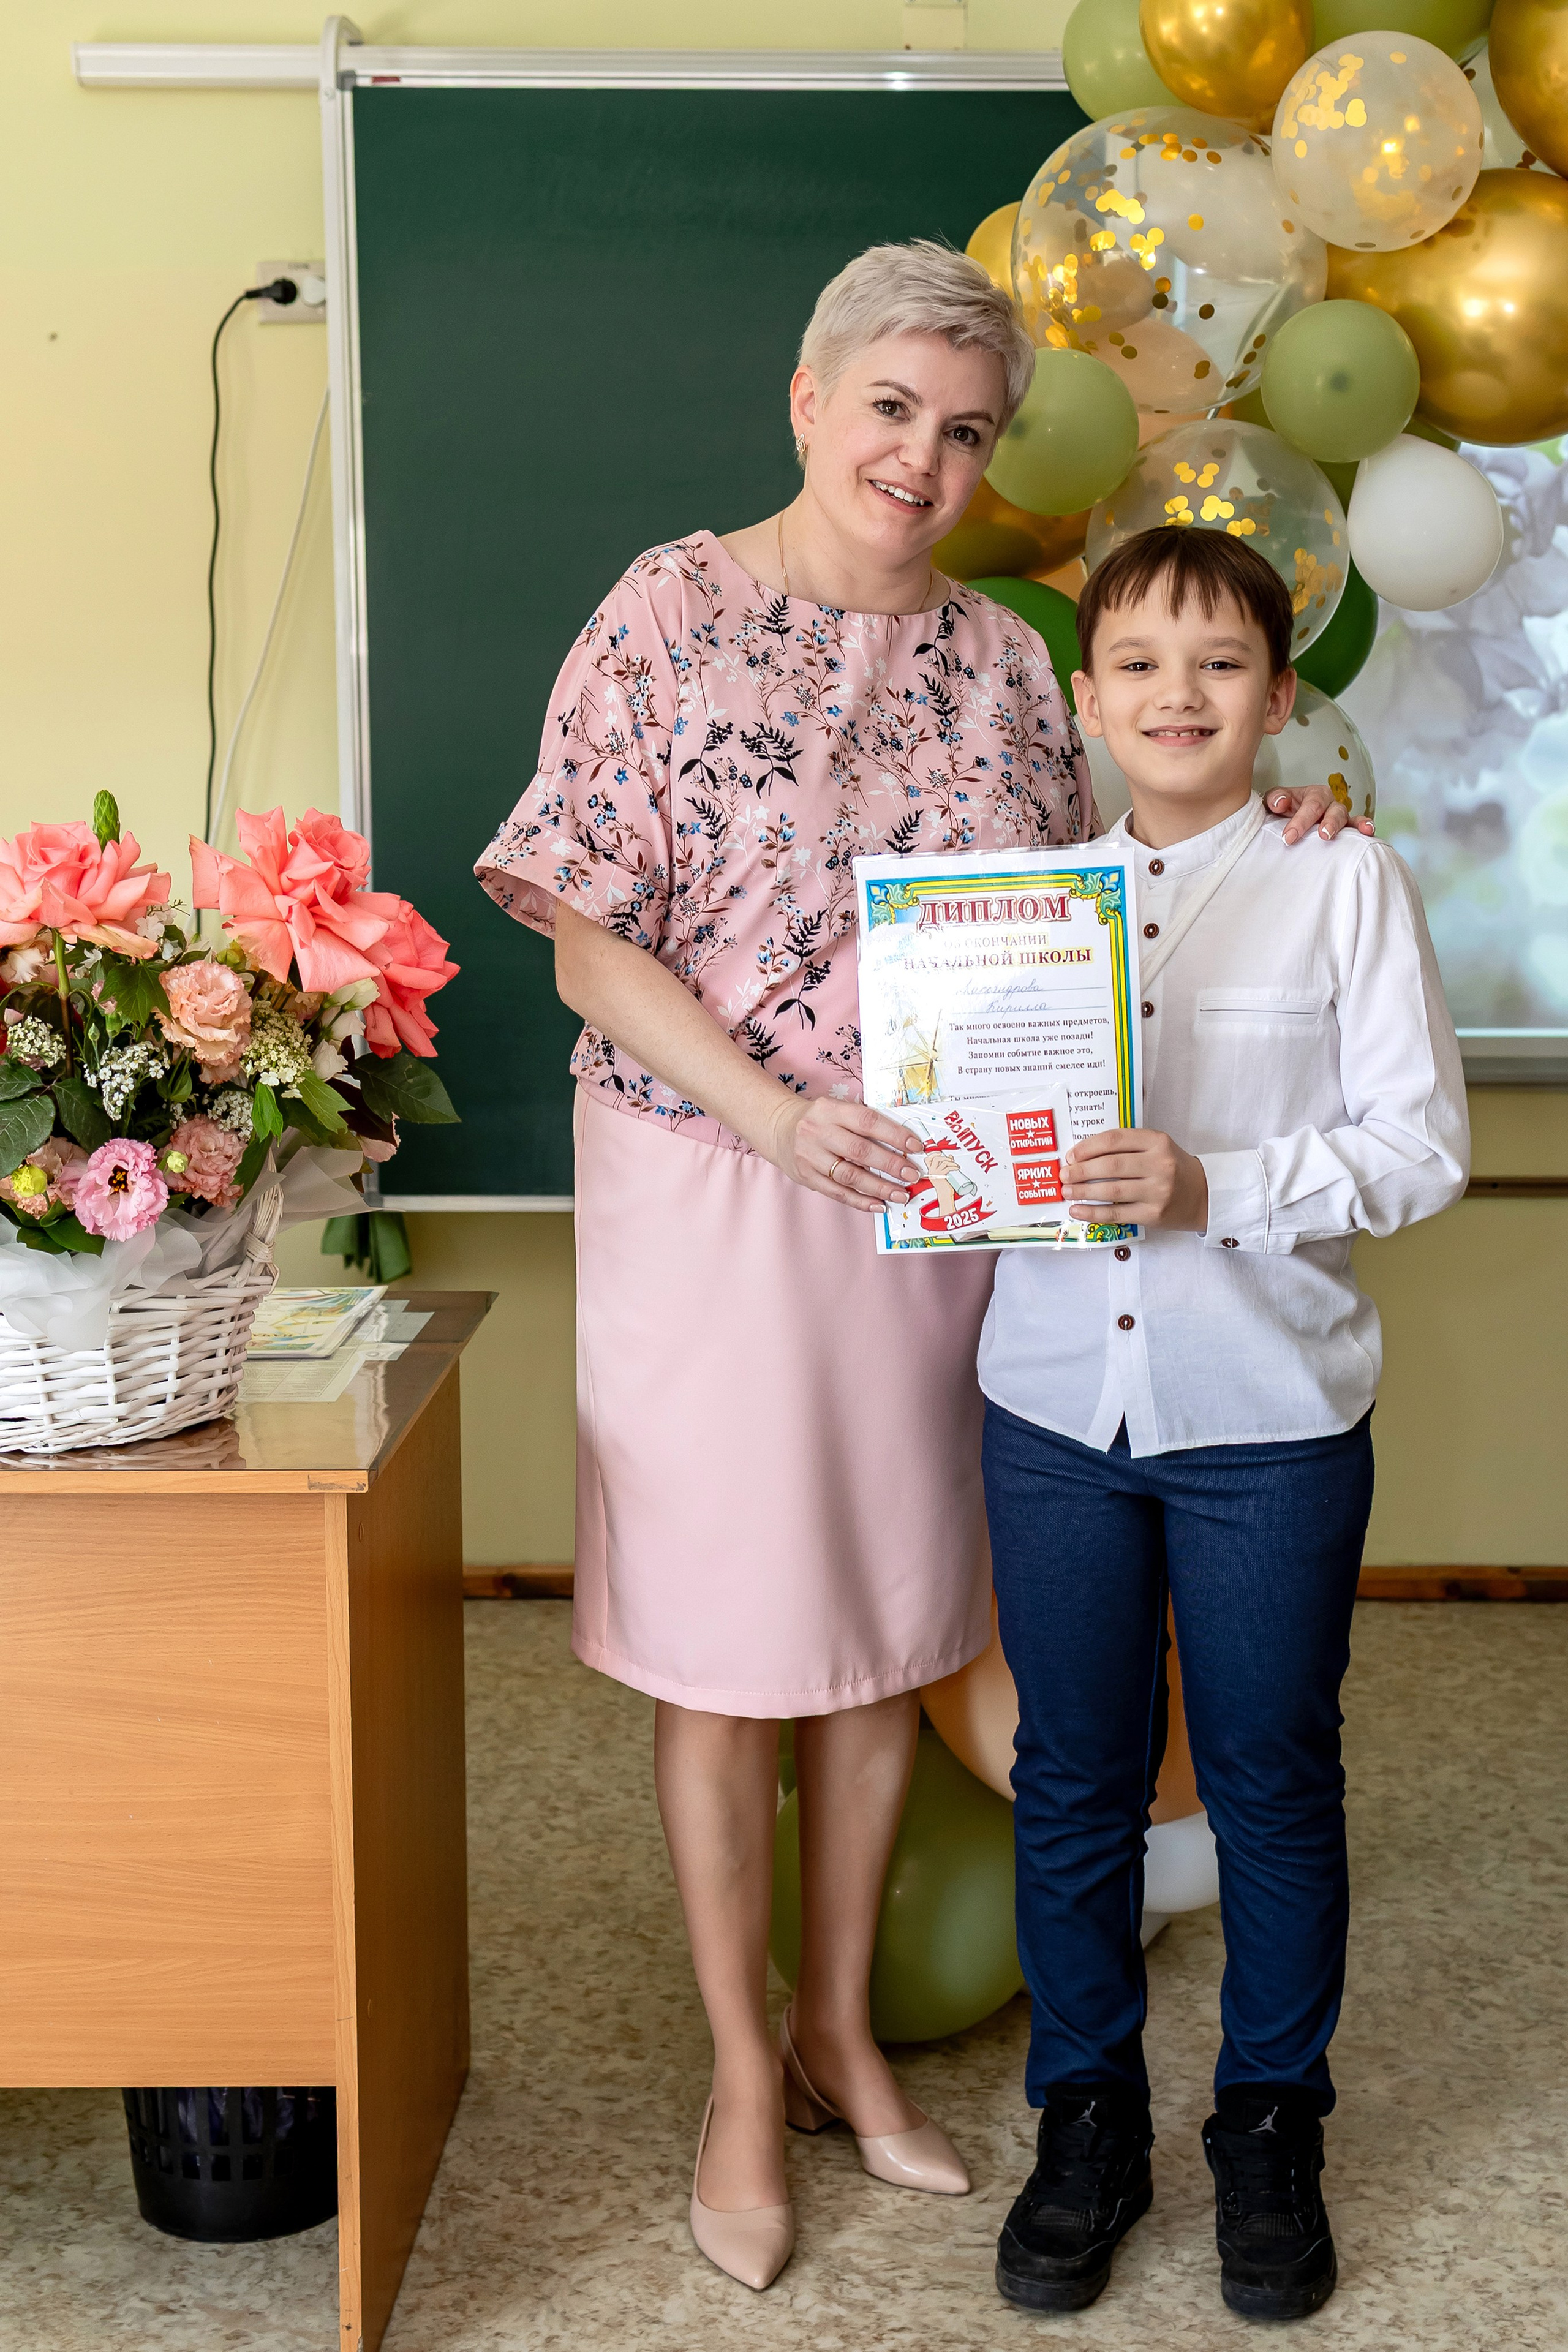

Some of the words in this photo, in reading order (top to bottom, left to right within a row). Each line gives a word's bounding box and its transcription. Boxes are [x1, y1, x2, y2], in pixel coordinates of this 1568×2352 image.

[918, 895, 1070, 930] ДИПЛОМ
[965, 934, 1047, 949] ОКОНЧАНИИ
[1019, 949, 1091, 965] ШКОЛЫ
[949, 1022, 964, 1031] Так
[1028, 1020, 1060, 1028] важных
[1063, 1018, 1110, 1028] предметов,
[967, 1036, 1011, 1045] Начальная
[1014, 1035, 1040, 1044] школа
[1042, 1035, 1058, 1045] уже
[1061, 1031, 1093, 1042] позади!
[968, 1051, 1005, 1060] Запомни
[1007, 1049, 1041, 1058] событие
[1044, 1048, 1074, 1057] важное
[1077, 1047, 1093, 1056] это,
[957, 1066, 963, 1074] В
[965, 1066, 993, 1076] страну
[995, 1065, 1021, 1074] новых
[1023, 1062, 1054, 1072] знаний
[1055, 1062, 1085, 1071] смелее
[1087, 1060, 1106, 1069] иди!
[1074, 1089, 1117, 1099] откроешь,
[1074, 1102, 1105, 1114] узнать!
[1009, 1116, 1049, 1131] НОВЫХ
[1081, 1118, 1105, 1128] уроке
[943, 1110, 998, 1174] ВЫПУСК
[1011, 1136, 1054, 1149] ОТКРЫТИЙ
[1017, 1166, 1054, 1181] ЯРКИХ
[1018, 1188, 1057, 1200] СОБЫТИЙ
[944, 1207, 980, 1231] 2025
